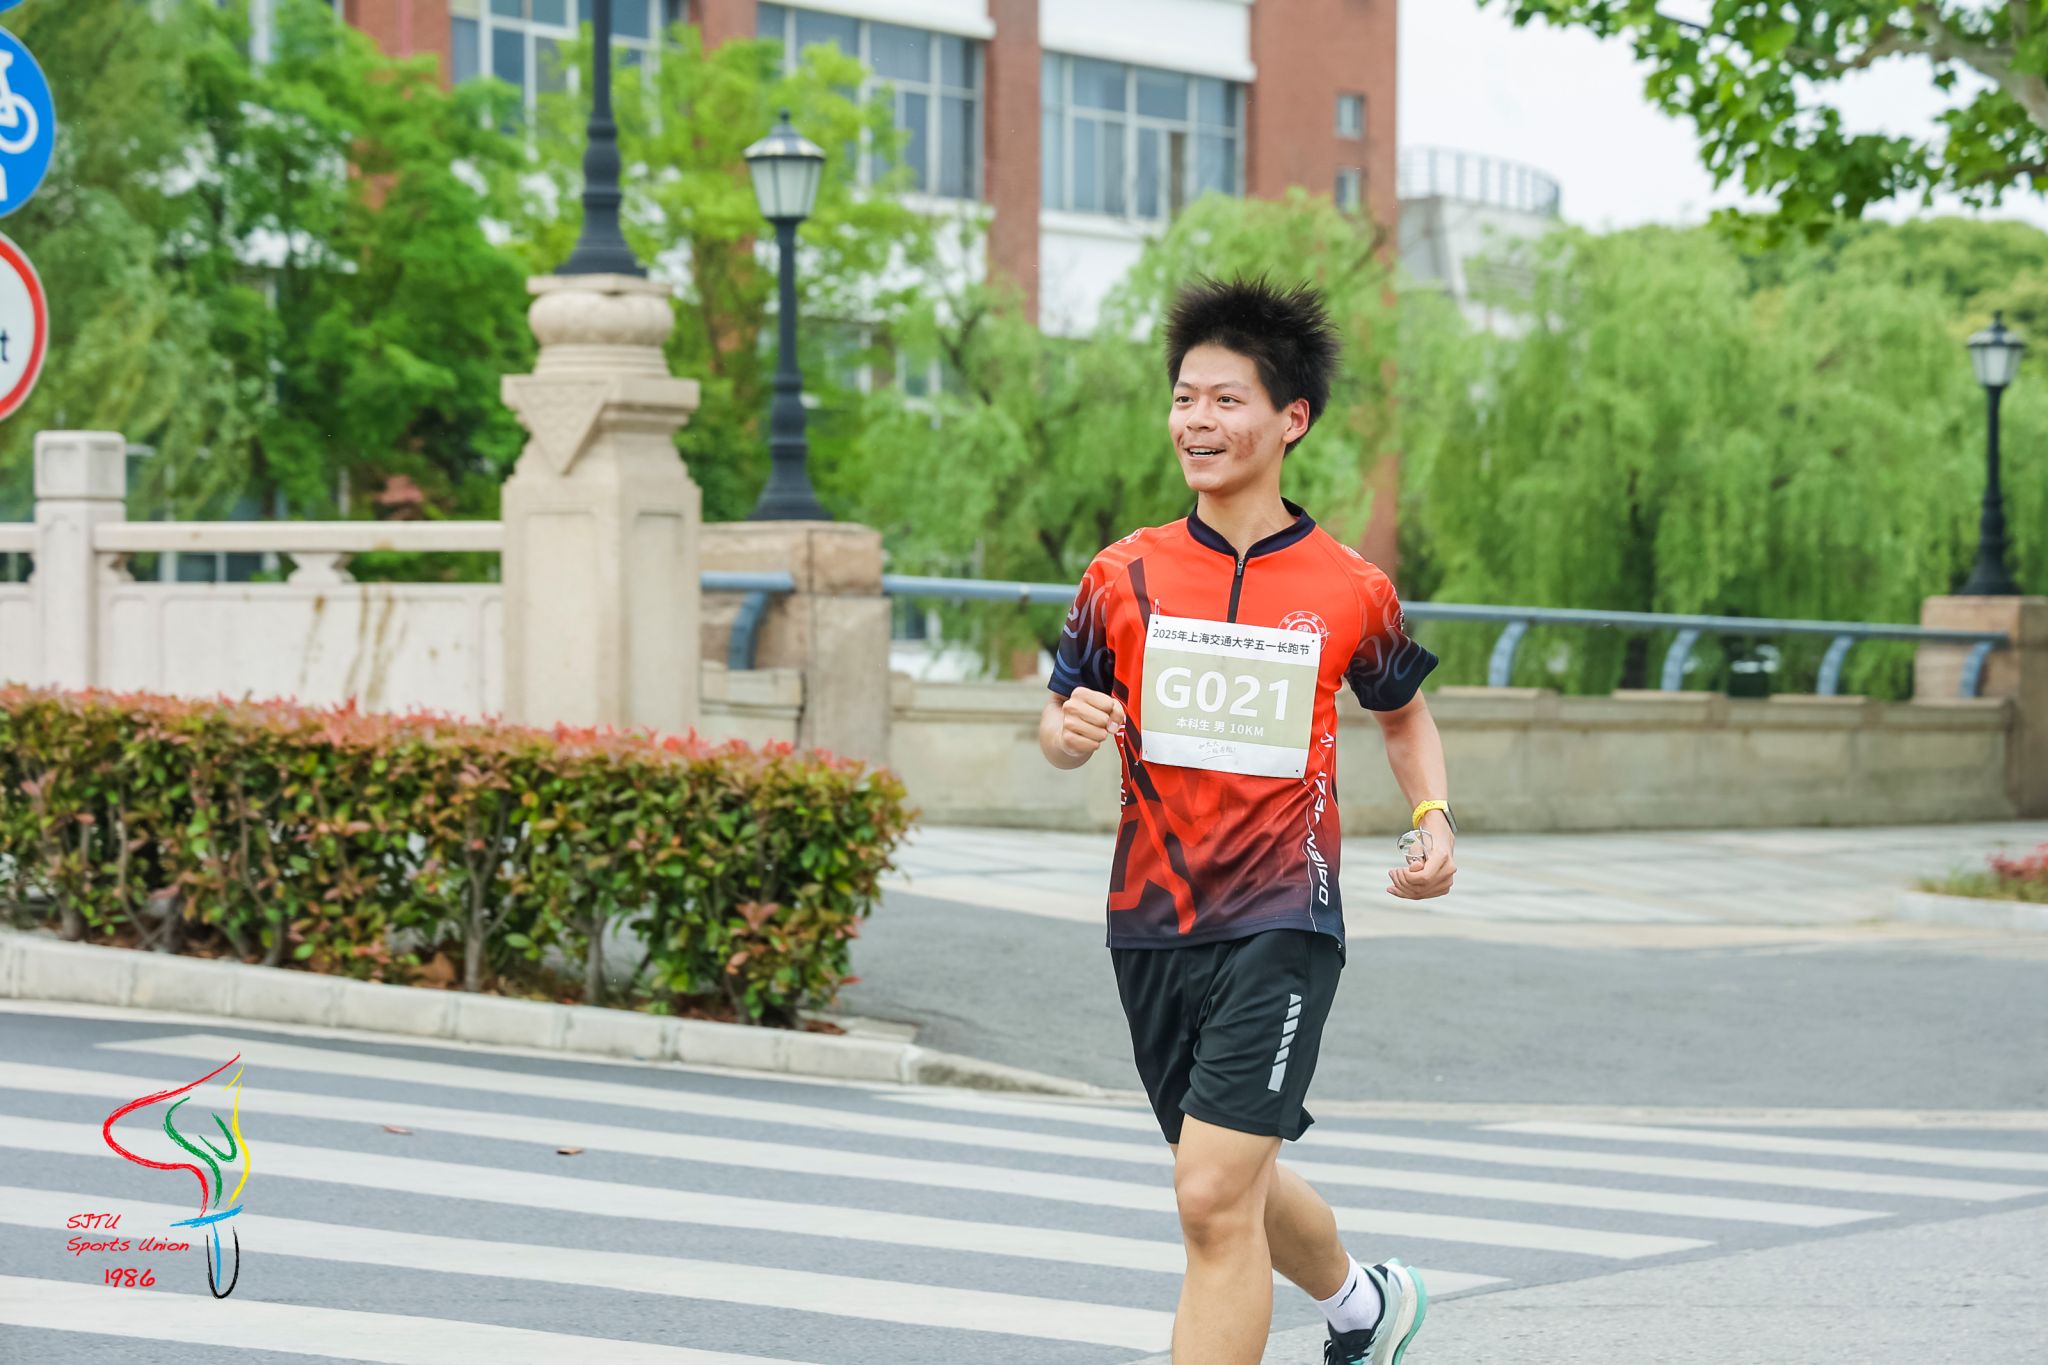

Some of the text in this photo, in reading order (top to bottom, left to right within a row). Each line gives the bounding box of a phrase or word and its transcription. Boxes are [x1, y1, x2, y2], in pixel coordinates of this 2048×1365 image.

[1152, 628, 1310, 655] 2025年上海交通大学五一长跑节
[1155, 666, 1289, 721] G021
[1176, 716, 1264, 737] 本科生 男 10KM
